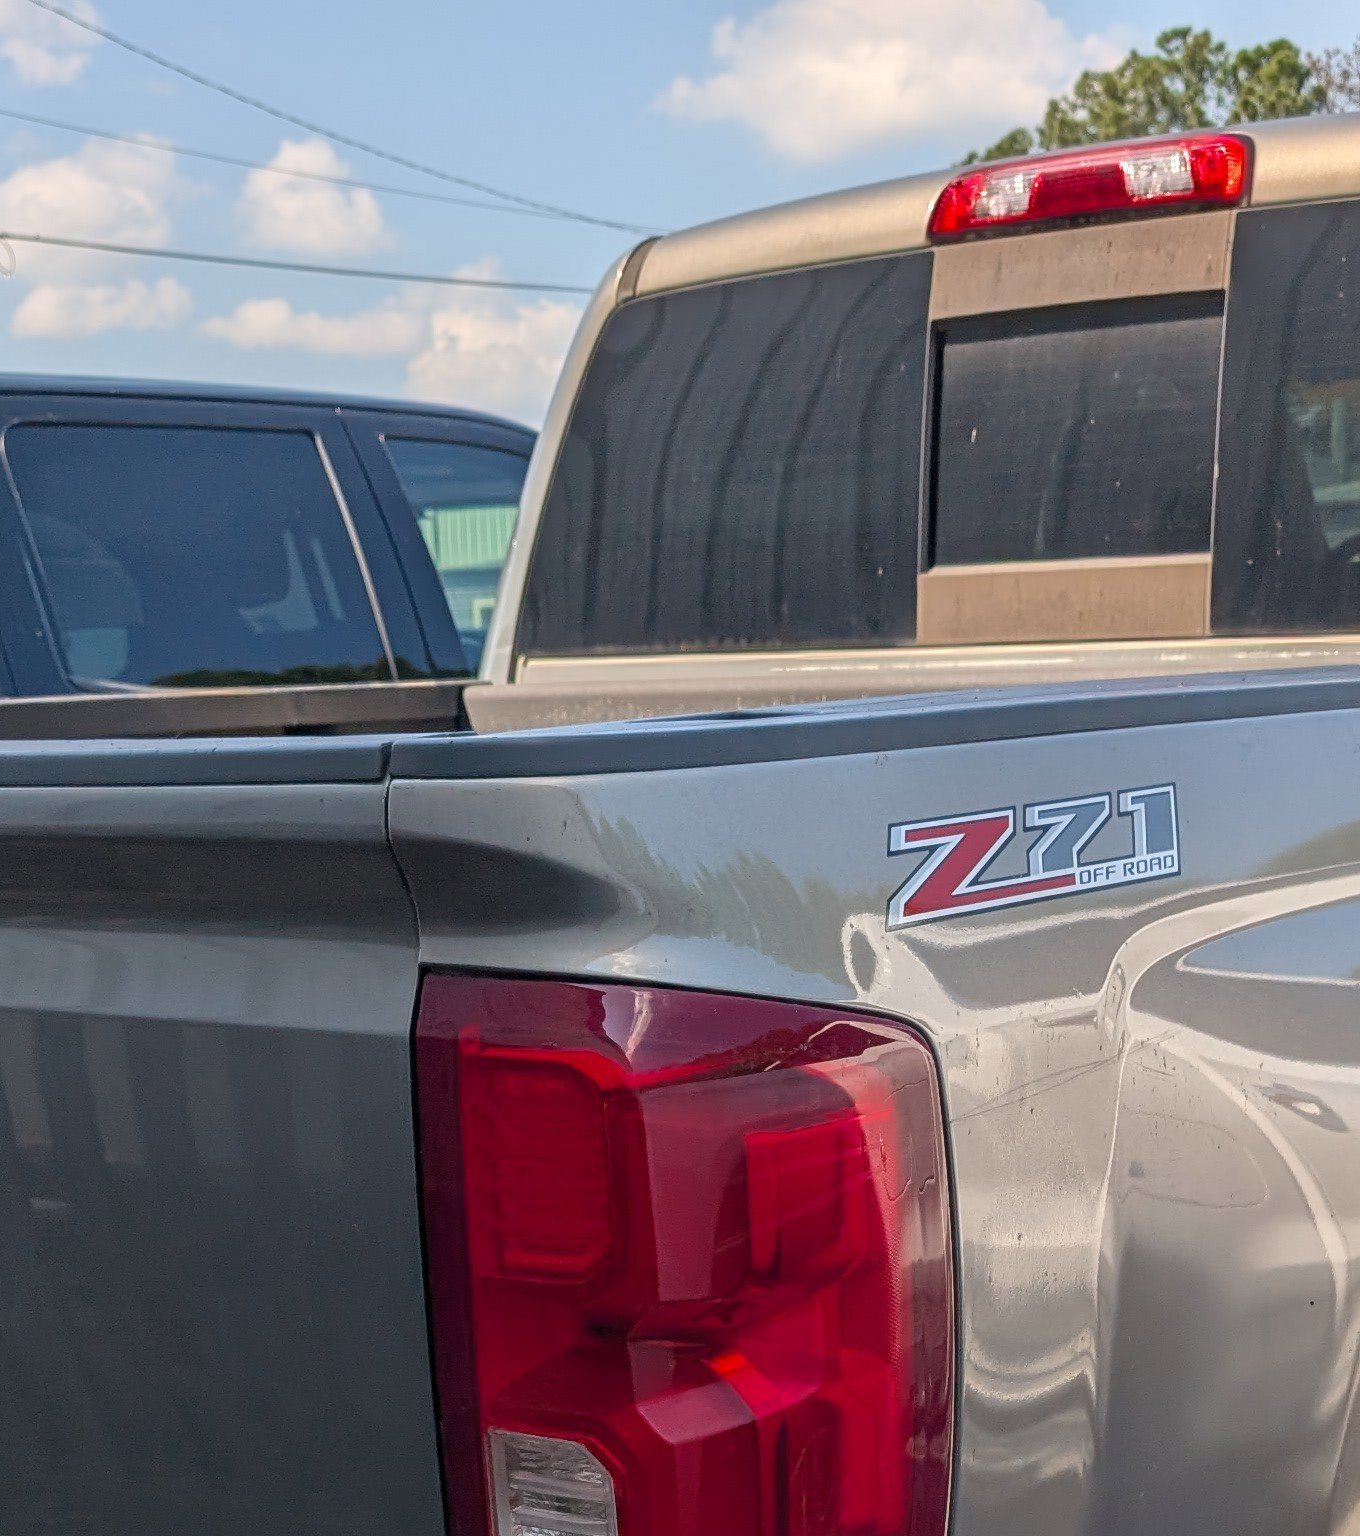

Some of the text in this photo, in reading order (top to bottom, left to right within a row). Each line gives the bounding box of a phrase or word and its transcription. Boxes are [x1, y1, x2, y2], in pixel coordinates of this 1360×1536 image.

[885, 782, 1181, 932] Z71
[1079, 854, 1175, 885] OFF ROAD
